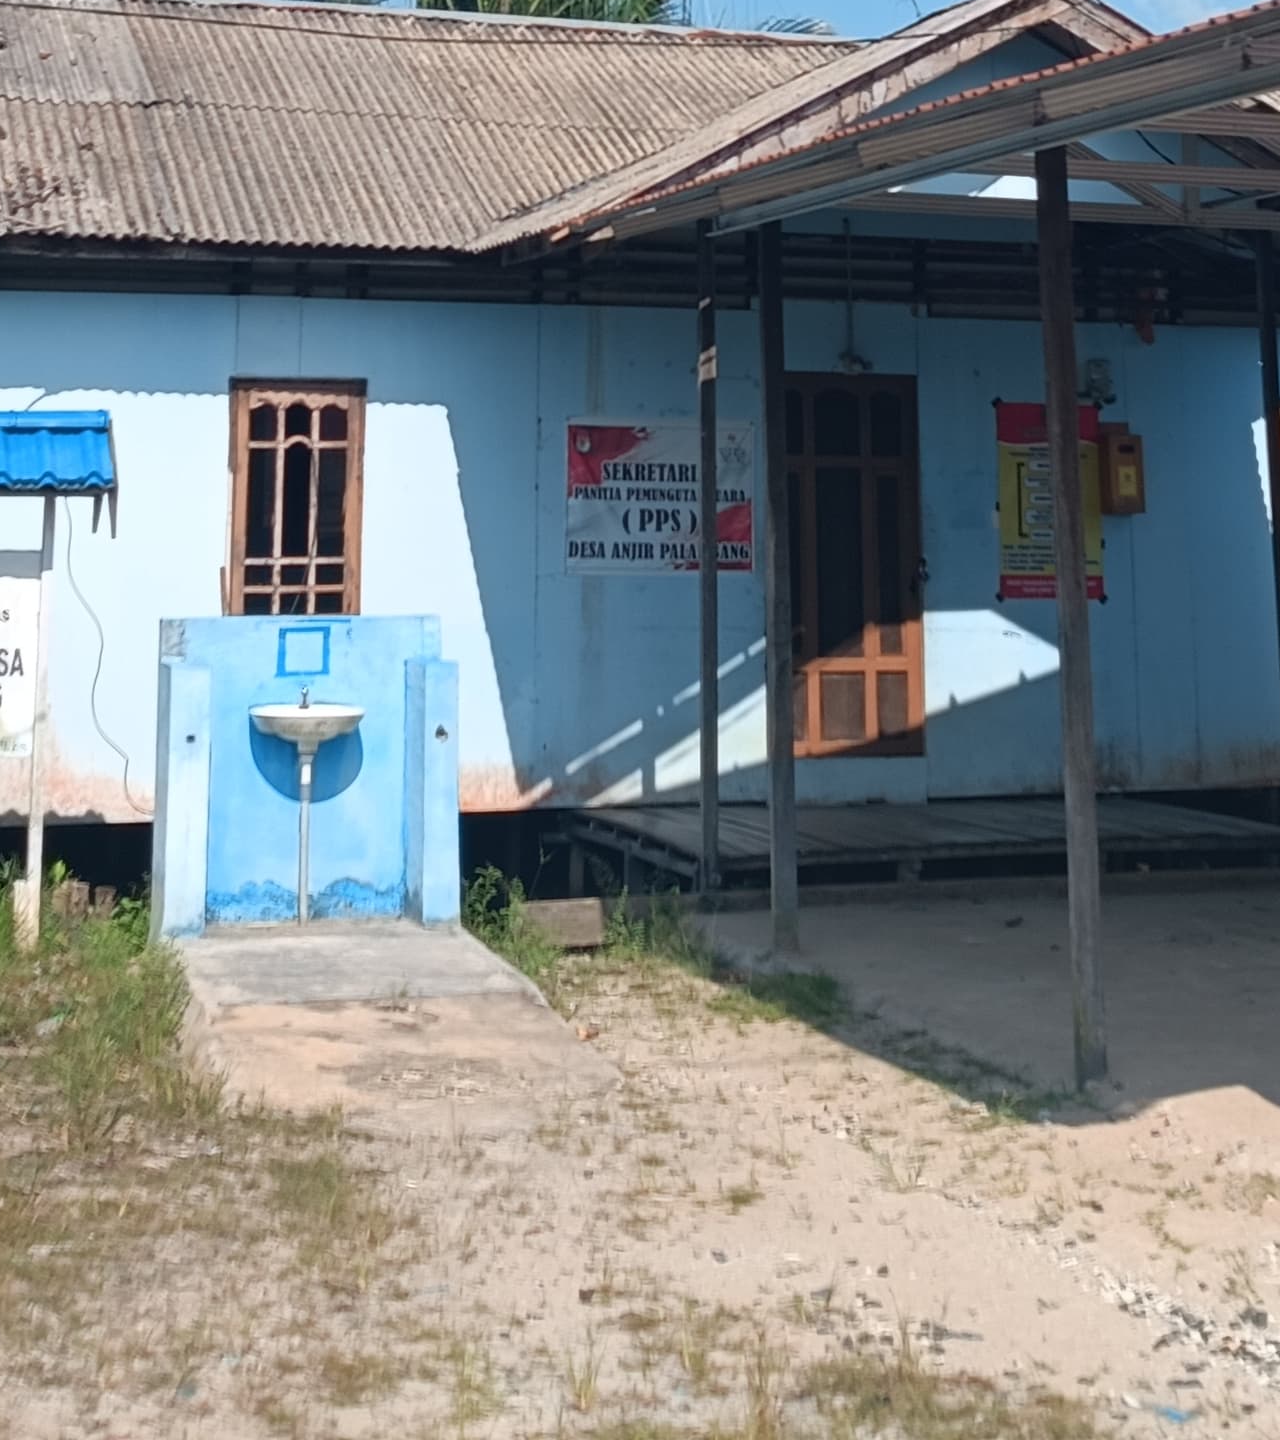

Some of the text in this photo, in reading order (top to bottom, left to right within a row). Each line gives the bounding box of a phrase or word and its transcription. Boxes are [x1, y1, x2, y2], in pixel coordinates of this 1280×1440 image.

[603, 462, 698, 483] SEKRETARI
[574, 486, 622, 501] PANITIA
[626, 487, 699, 503] PEMUNGUTA
[638, 509, 682, 533] PPS
[568, 540, 749, 562] DESA ANJIR PALAANG
